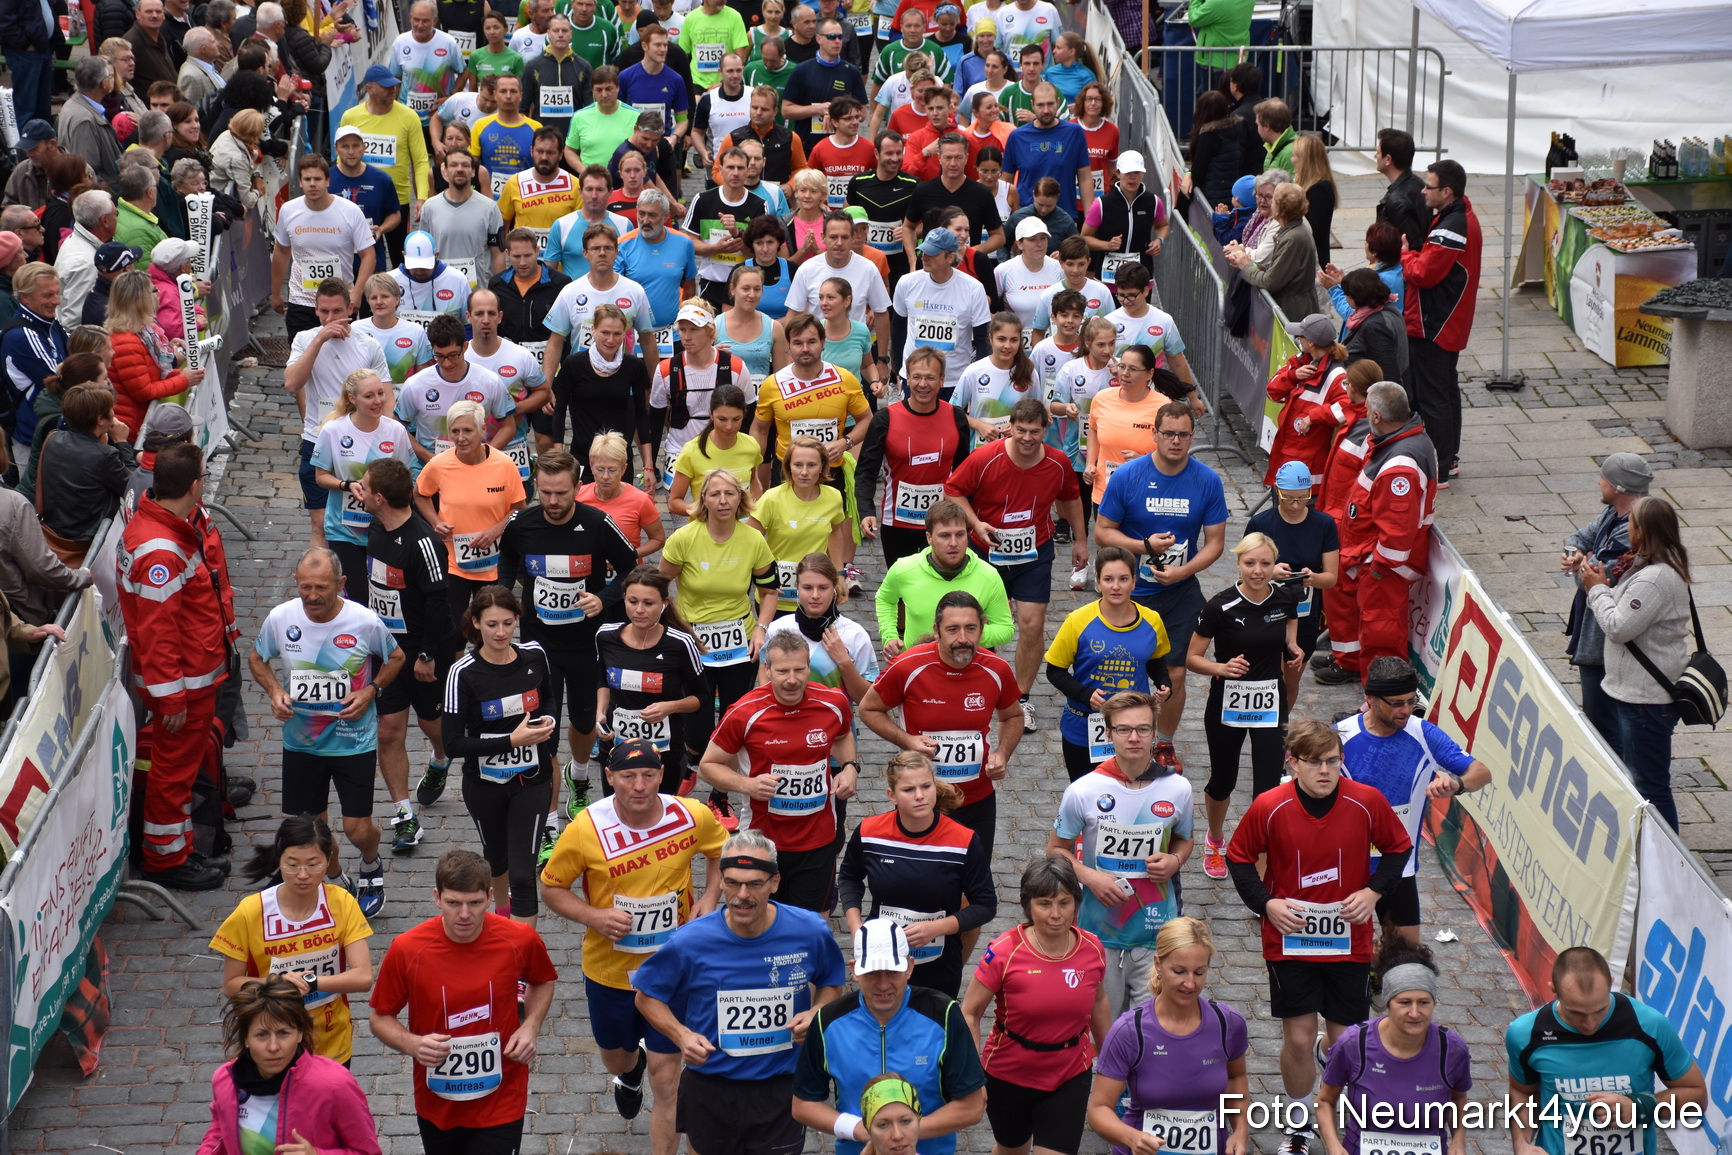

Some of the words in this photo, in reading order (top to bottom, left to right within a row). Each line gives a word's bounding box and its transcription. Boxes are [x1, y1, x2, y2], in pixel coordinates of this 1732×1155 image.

[699, 50, 722, 61] 2153
[410, 99, 434, 110] 3057
[543, 94, 570, 106] 2454
[364, 142, 393, 156] 2214
[522, 198, 544, 209] MAX
[548, 194, 573, 205] BÖGL
[199, 200, 209, 246] Laufsport
[294, 225, 335, 234] Continental
[197, 247, 205, 273] BMW
[309, 265, 334, 279] 359
[184, 299, 195, 324] BMW
[918, 325, 953, 340] 2008
[784, 396, 811, 410] MAX
[816, 386, 845, 400] BÖGL
[902, 494, 939, 509] 2132
[1146, 498, 1190, 508] HUBER
[474, 561, 491, 569] Anita
[536, 580, 552, 588] PARTL
[539, 590, 579, 608] 2364
[544, 611, 573, 620] Dominik
[713, 622, 736, 630] Neumarkt
[701, 629, 743, 649] 2079
[713, 652, 733, 661] Sonja
[297, 682, 346, 701] 2410
[1230, 692, 1273, 709] 2103
[504, 707, 523, 715] MÜLLER
[1238, 713, 1263, 721] Andrea
[619, 721, 665, 739] 2392
[485, 746, 533, 765] 2496
[934, 743, 977, 763] 2781
[794, 768, 820, 776] Neumarkt
[937, 767, 968, 776] Berthold
[777, 776, 823, 795] 2588
[781, 800, 816, 810] Wolfgang
[1155, 805, 1173, 814] Hervis
[1100, 825, 1122, 834] PARTL
[1103, 836, 1155, 857] 2471
[608, 854, 651, 878] MAX
[655, 836, 697, 860] BÖGL
[1119, 861, 1136, 871] Hepi
[1468, 783, 1593, 948] FLASTERSTEINE
[1313, 874, 1328, 882] DEHN
[638, 900, 669, 909] Neumarkt
[881, 910, 902, 919] PARTL
[1146, 908, 1160, 917] 16.
[265, 944, 298, 955] MAX
[303, 934, 338, 947] BÖGL
[638, 936, 655, 945] Ralf
[1301, 939, 1332, 947] Manuel
[296, 955, 329, 965] Neumarkt
[774, 952, 808, 961] NEUMARKTER
[773, 958, 802, 966] STADTLAUF
[745, 994, 781, 1002] Neumarkt
[460, 1012, 478, 1022] DEHN
[727, 1004, 786, 1030] 2238
[452, 1042, 488, 1050] Neumarkt
[740, 1036, 774, 1046] Werner
[435, 1050, 494, 1076] 2290
[445, 1081, 484, 1091] Andreas
[1555, 1075, 1631, 1092] HUBER
[1146, 1113, 1169, 1122] PARTL
[1152, 1125, 1211, 1150] 3020
[1391, 1139, 1427, 1148] Neumarkt
[1574, 1132, 1635, 1154] 2621
